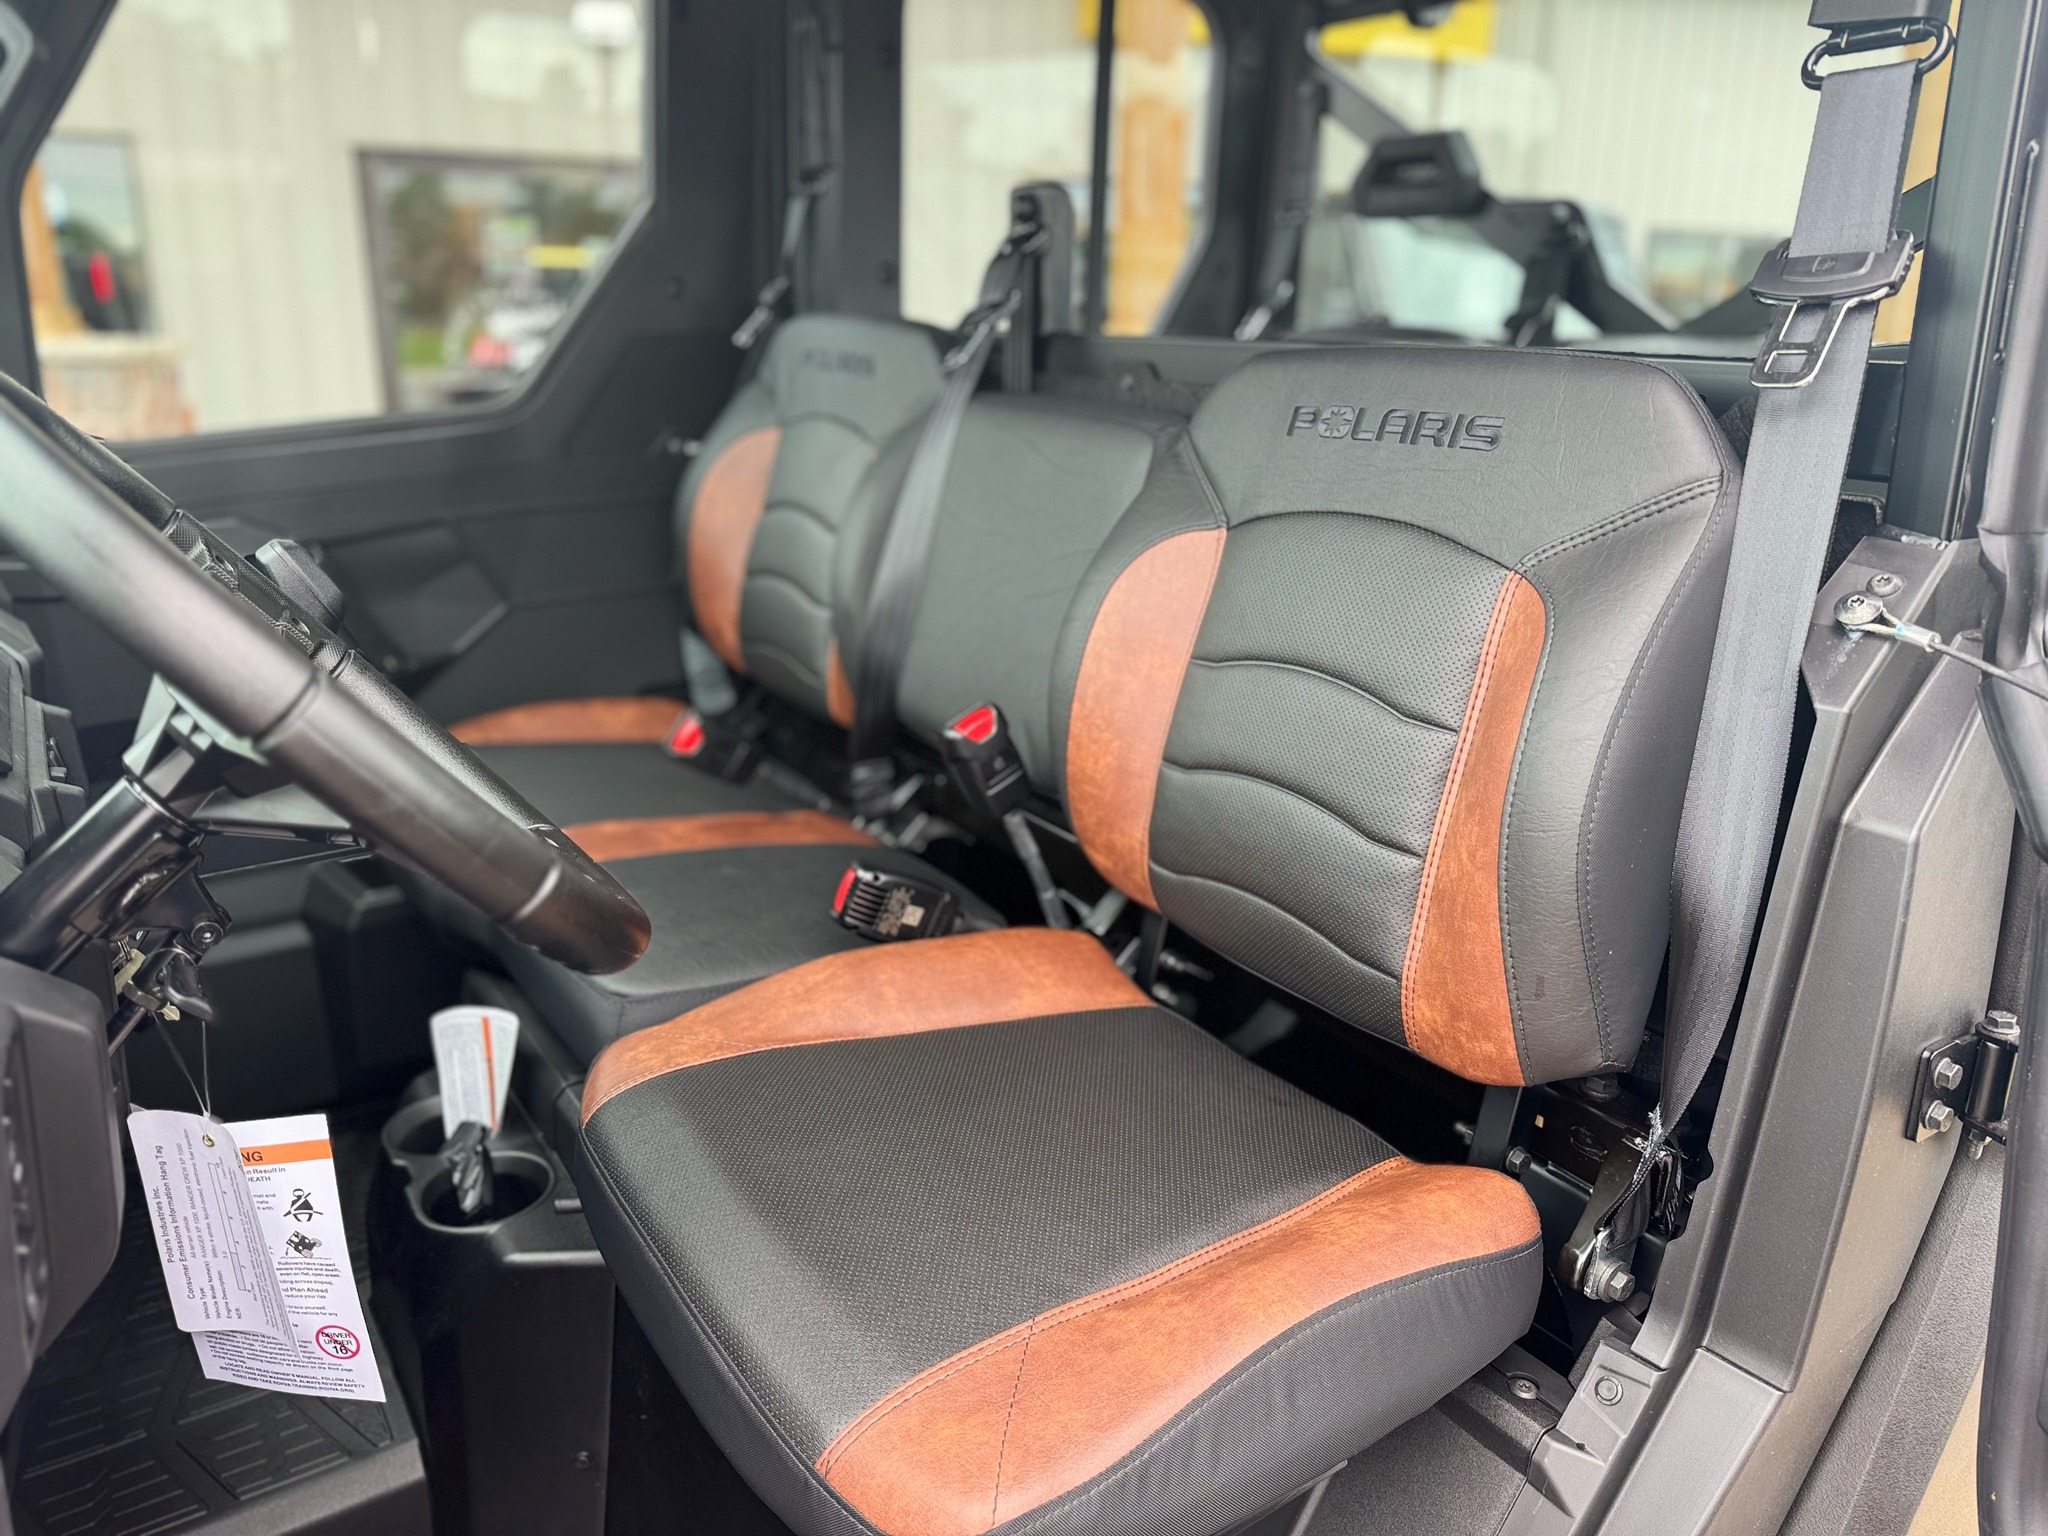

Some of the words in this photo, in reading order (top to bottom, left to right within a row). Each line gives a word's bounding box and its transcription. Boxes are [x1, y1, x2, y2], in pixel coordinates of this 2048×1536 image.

[1286, 405, 1505, 451] POLARIS
[155, 1146, 163, 1160] Tag
[159, 1161, 168, 1180] Hang
[156, 1201, 169, 1237] Industries
[164, 1182, 178, 1224] Information
[164, 1238, 175, 1263] Polaris
[174, 1226, 187, 1262] Emissions
[182, 1264, 195, 1300] Consumer
[332, 1346, 349, 1354] 16
